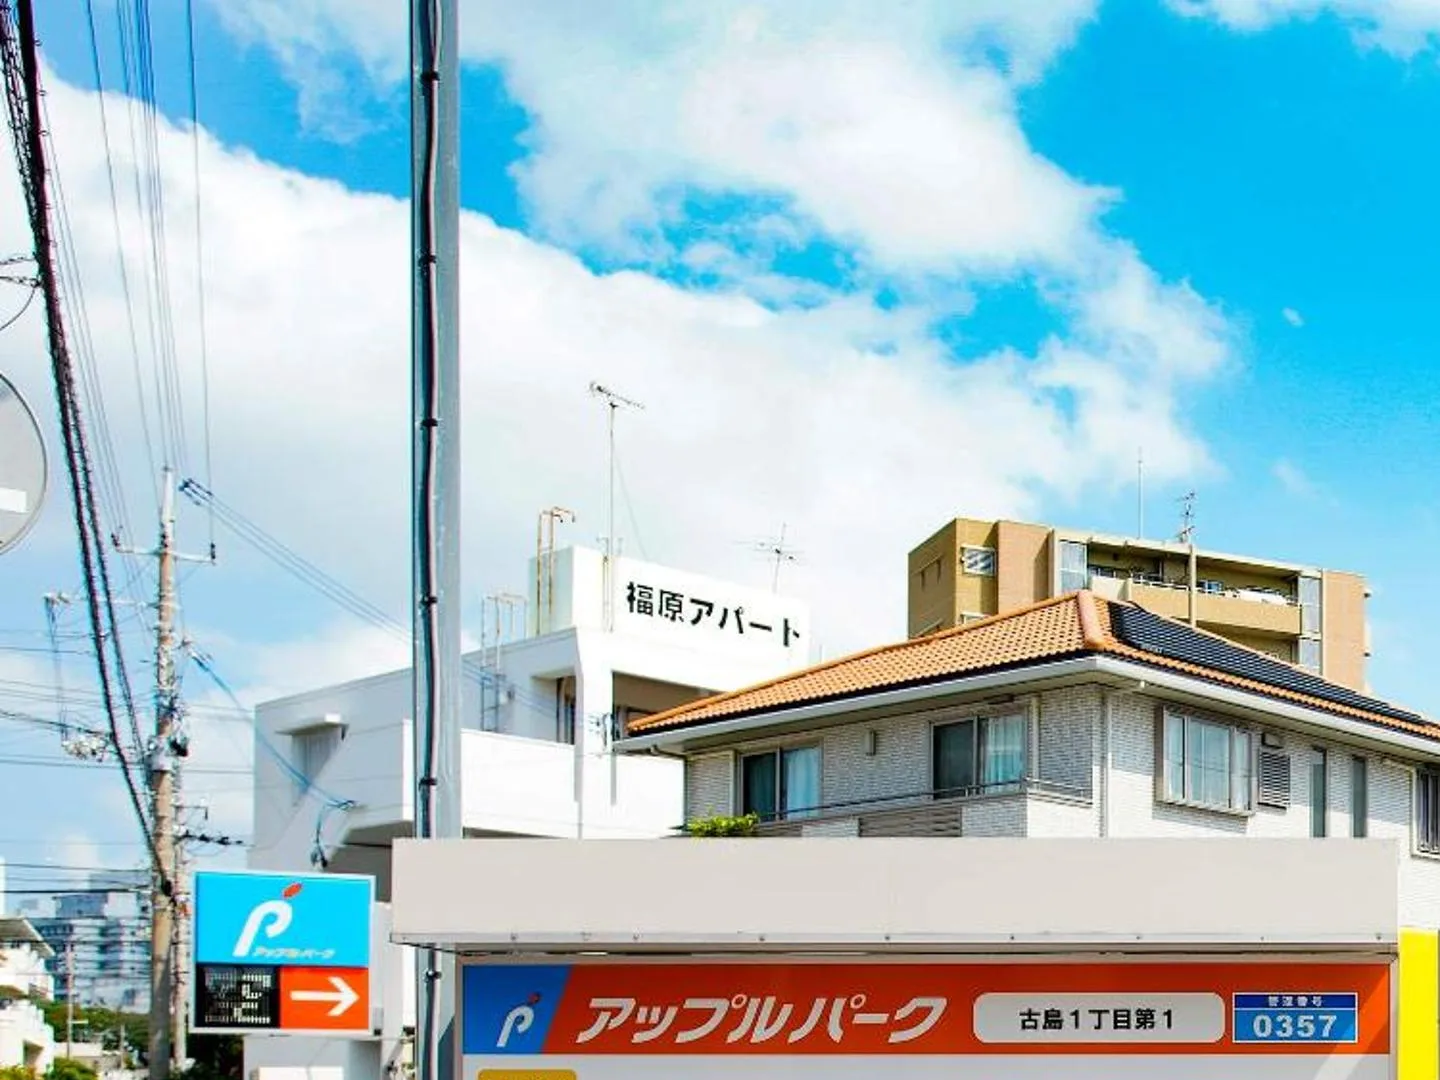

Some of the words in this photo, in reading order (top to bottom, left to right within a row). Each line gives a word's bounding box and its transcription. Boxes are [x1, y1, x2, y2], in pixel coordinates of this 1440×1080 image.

[627, 581, 800, 647] 福原アパート
[575, 994, 948, 1044] アップルパーク
[1252, 1014, 1337, 1039] 0357
